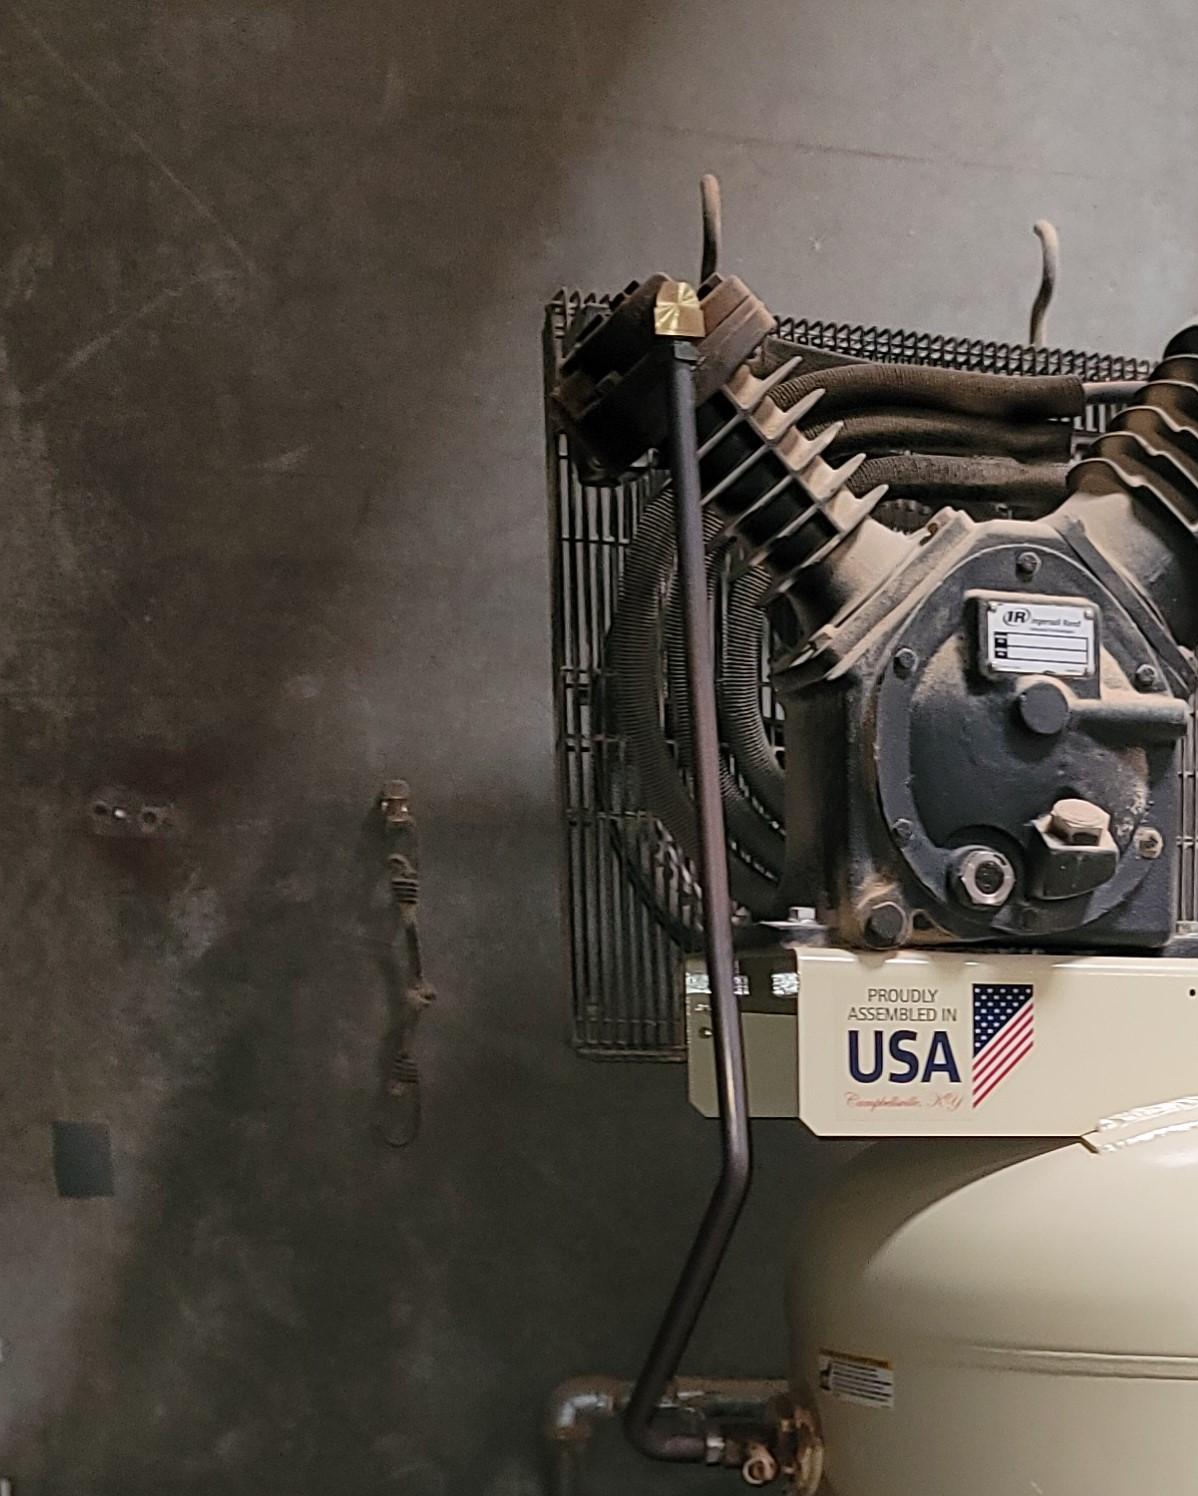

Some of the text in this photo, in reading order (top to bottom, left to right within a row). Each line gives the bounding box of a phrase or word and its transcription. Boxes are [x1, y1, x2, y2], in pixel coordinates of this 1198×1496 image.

[1007, 611, 1027, 624] IR
[867, 987, 939, 1003] PROUDLY
[847, 1006, 958, 1022] ASSEMBLED IN
[847, 1029, 962, 1084] USA
